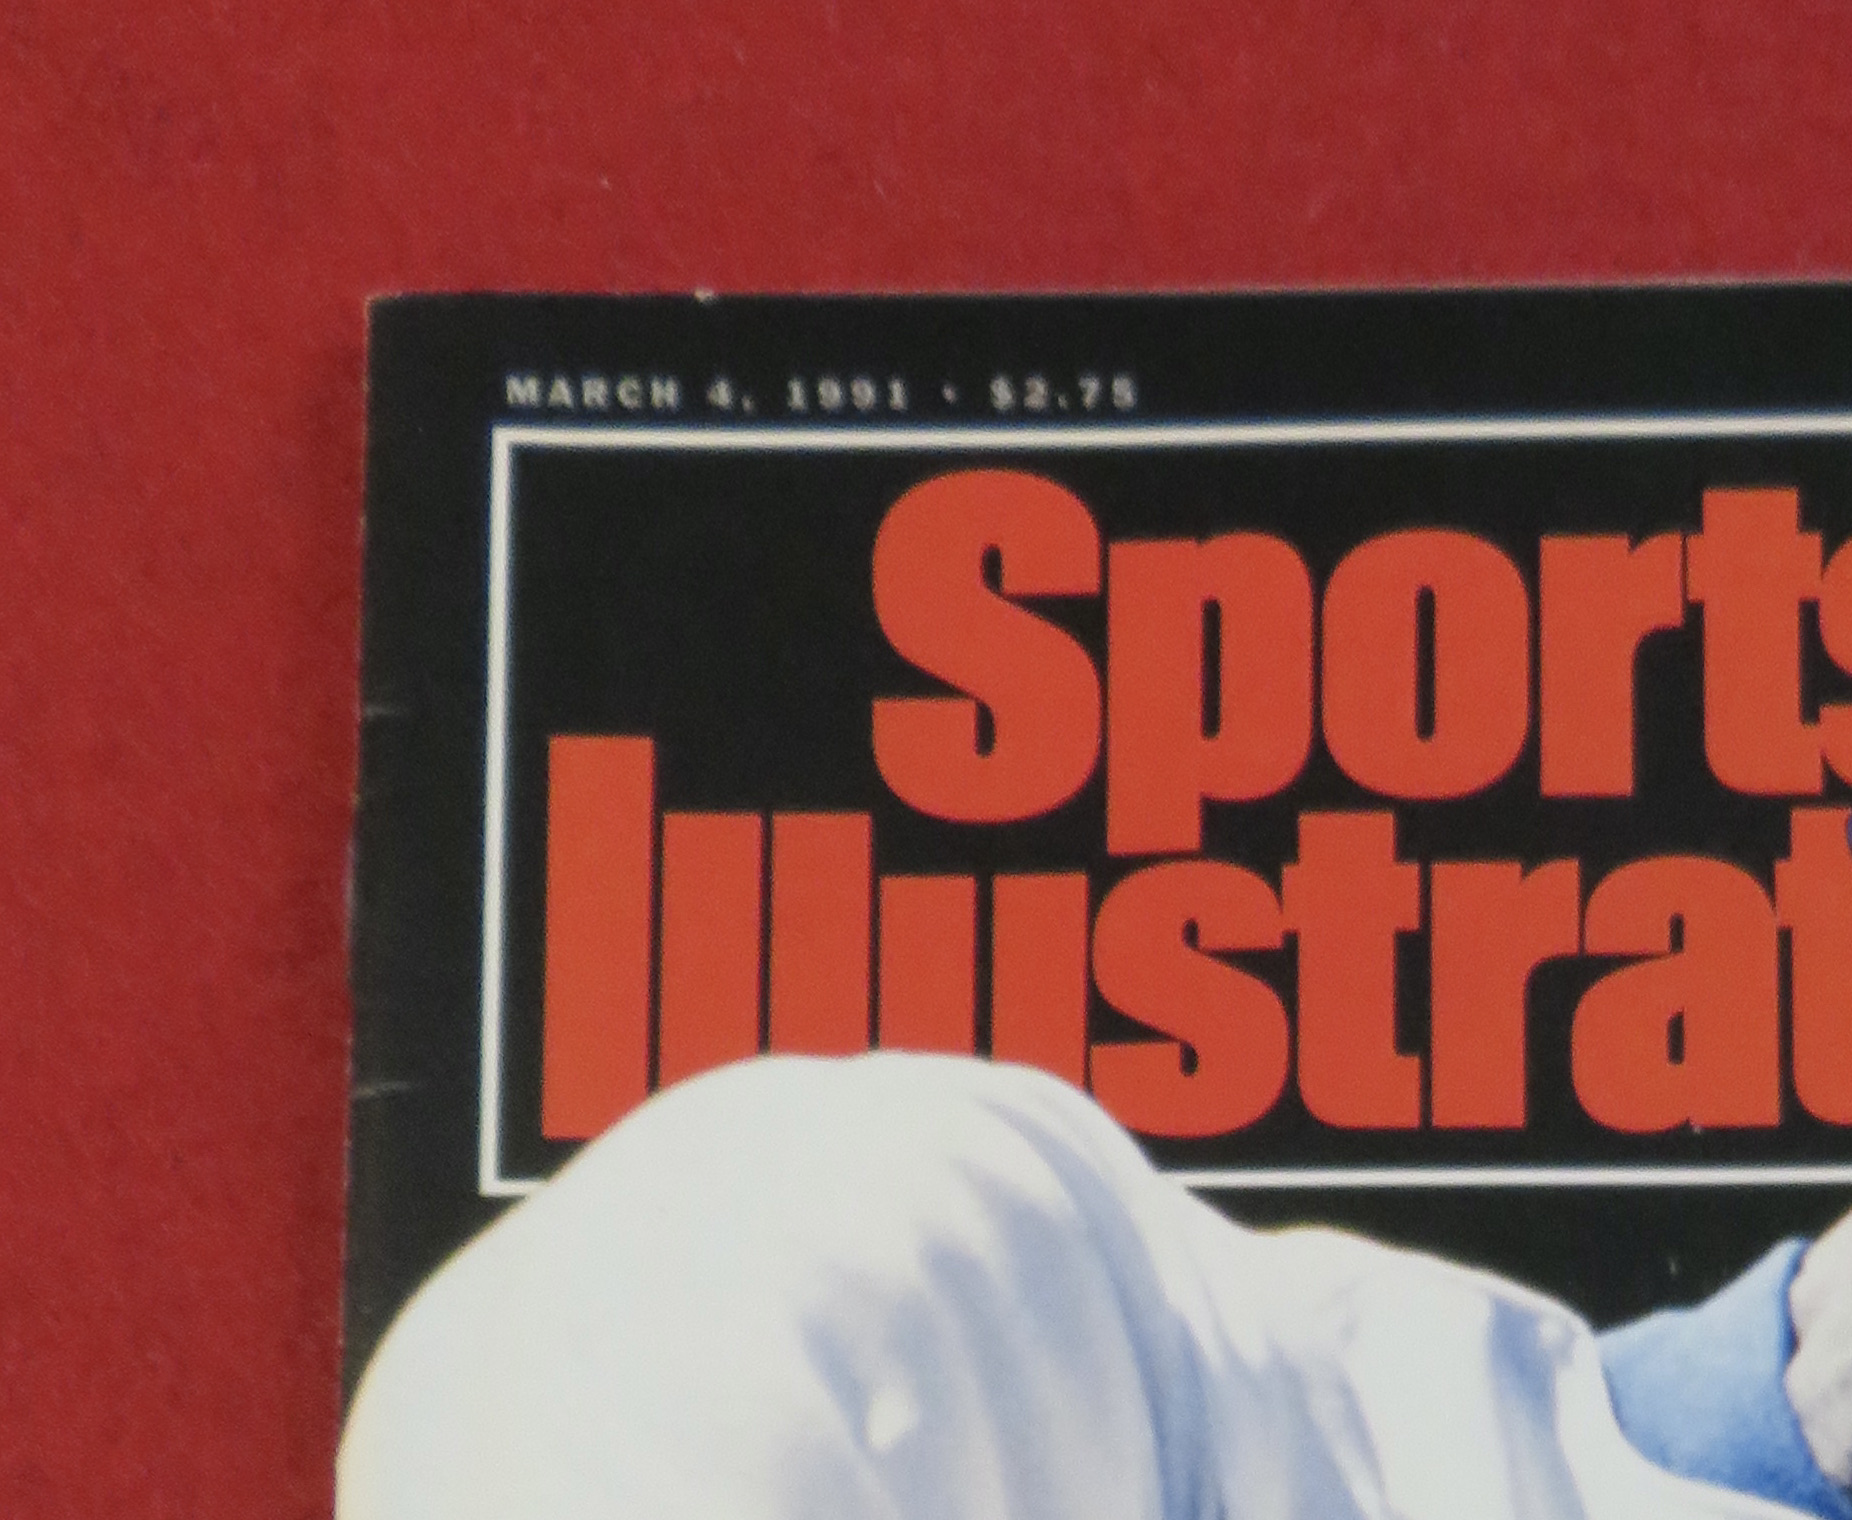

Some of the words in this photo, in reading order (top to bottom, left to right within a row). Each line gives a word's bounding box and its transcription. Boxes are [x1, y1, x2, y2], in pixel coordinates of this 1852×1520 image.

[506, 374, 681, 411] MARCH
[787, 375, 909, 411] 1991
[989, 374, 1139, 410] $2.75
